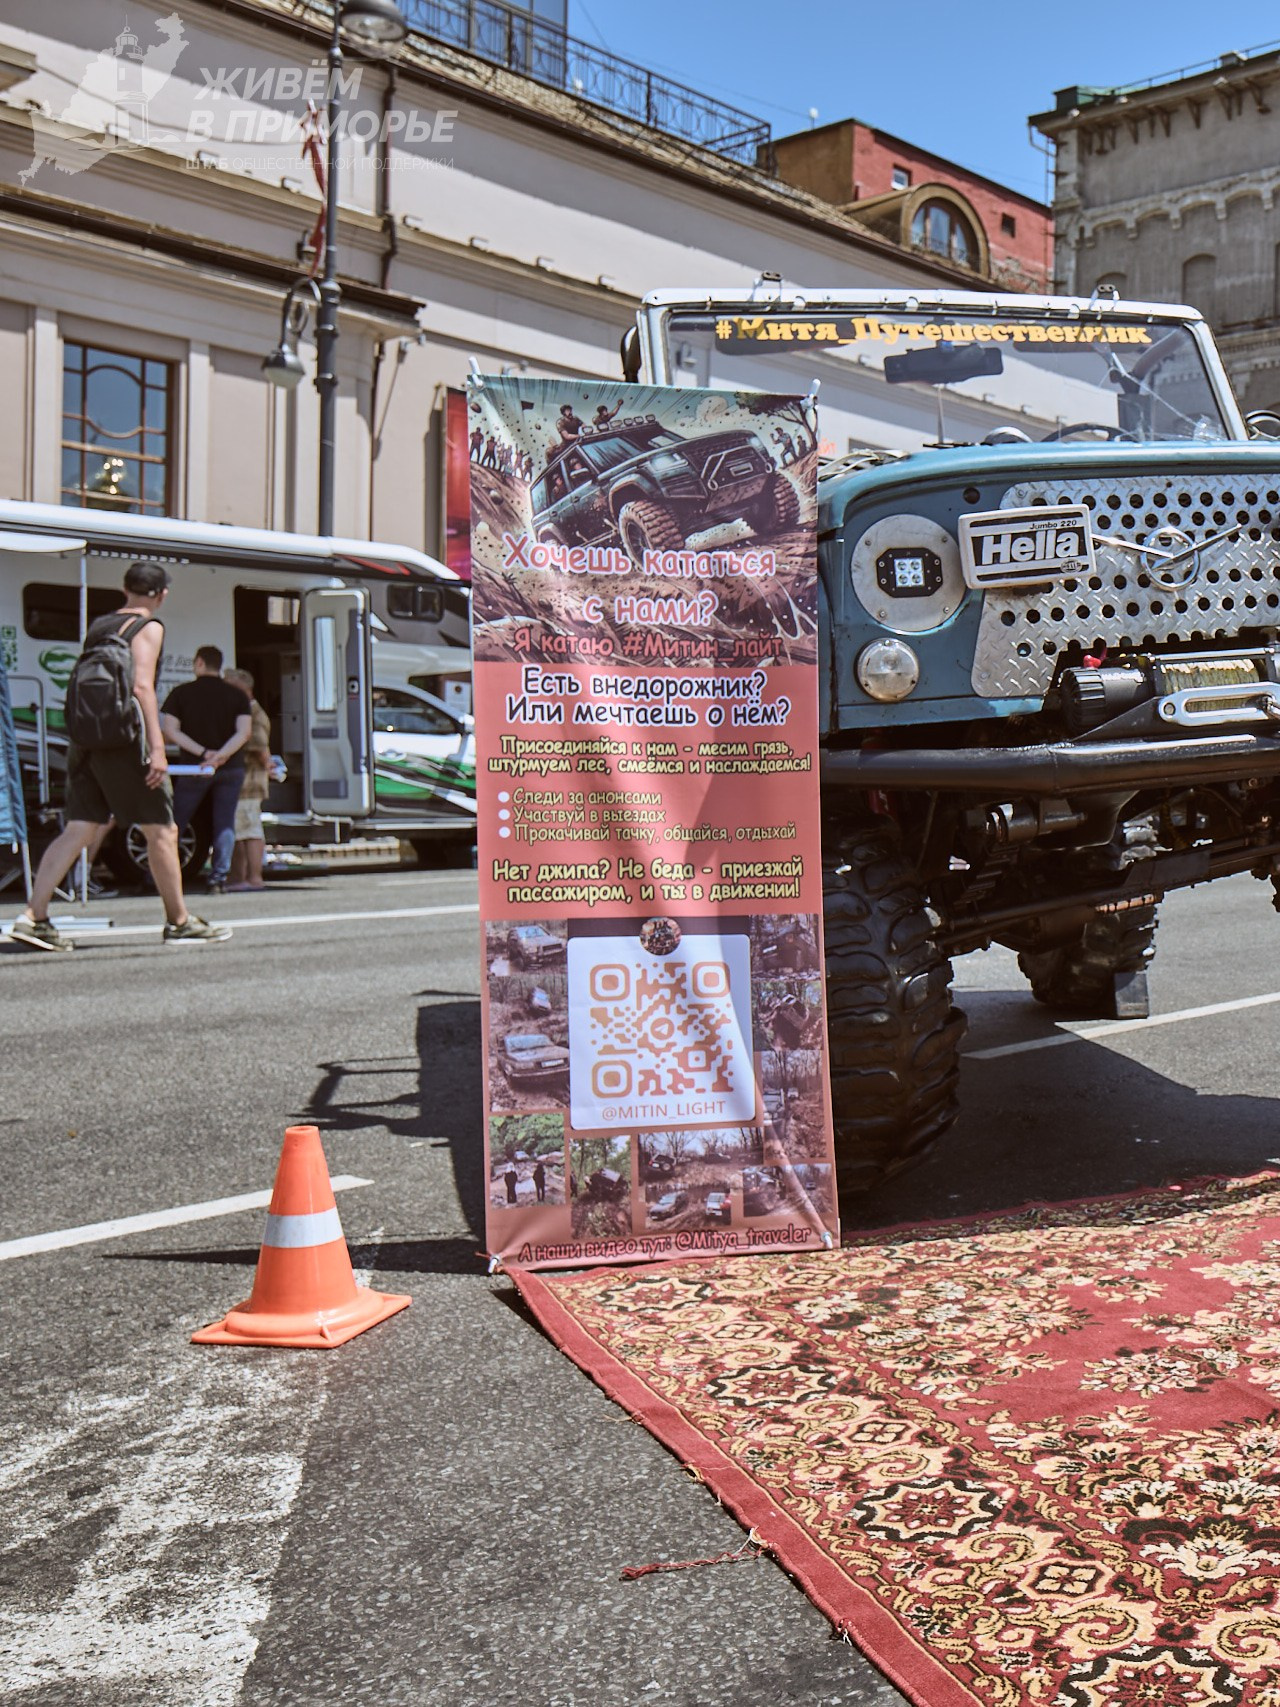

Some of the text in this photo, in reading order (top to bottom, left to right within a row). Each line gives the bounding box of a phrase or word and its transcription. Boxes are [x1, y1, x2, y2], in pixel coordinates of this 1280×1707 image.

[1030, 519, 1077, 530] Jumbo 220
[505, 534, 776, 576] Хочешь кататься
[982, 529, 1080, 565] Hella
[584, 591, 718, 624] с нами?
[514, 626, 783, 662] Я катаю #Митин_лайт
[524, 667, 766, 704] Есть внедорожник?
[508, 697, 790, 725] Или мечтаешь о нём?
[500, 736, 627, 757] Присоединяйся
[632, 742, 642, 755] к
[649, 742, 677, 756] нам
[699, 742, 748, 756] месим
[754, 741, 793, 758] грязь,
[489, 754, 811, 777] штурмуем лес, смеёмся и наслаждаемся!
[513, 787, 662, 806] Следи за анонсами
[514, 807, 665, 826] Участвуй в выездах
[515, 822, 796, 845] Прокачивай тачку, общайся, отдыхай
[493, 860, 530, 880] Нет
[537, 860, 610, 883] джипа?
[619, 858, 645, 879] Не
[651, 858, 694, 880] беда
[721, 856, 803, 882] приезжай
[508, 878, 799, 907] пассажиром, и ты в движении!
[602, 1100, 727, 1121] @MITIN_LIGHT
[518, 1223, 813, 1262] А наши видео тут: @Mitya_traveler
